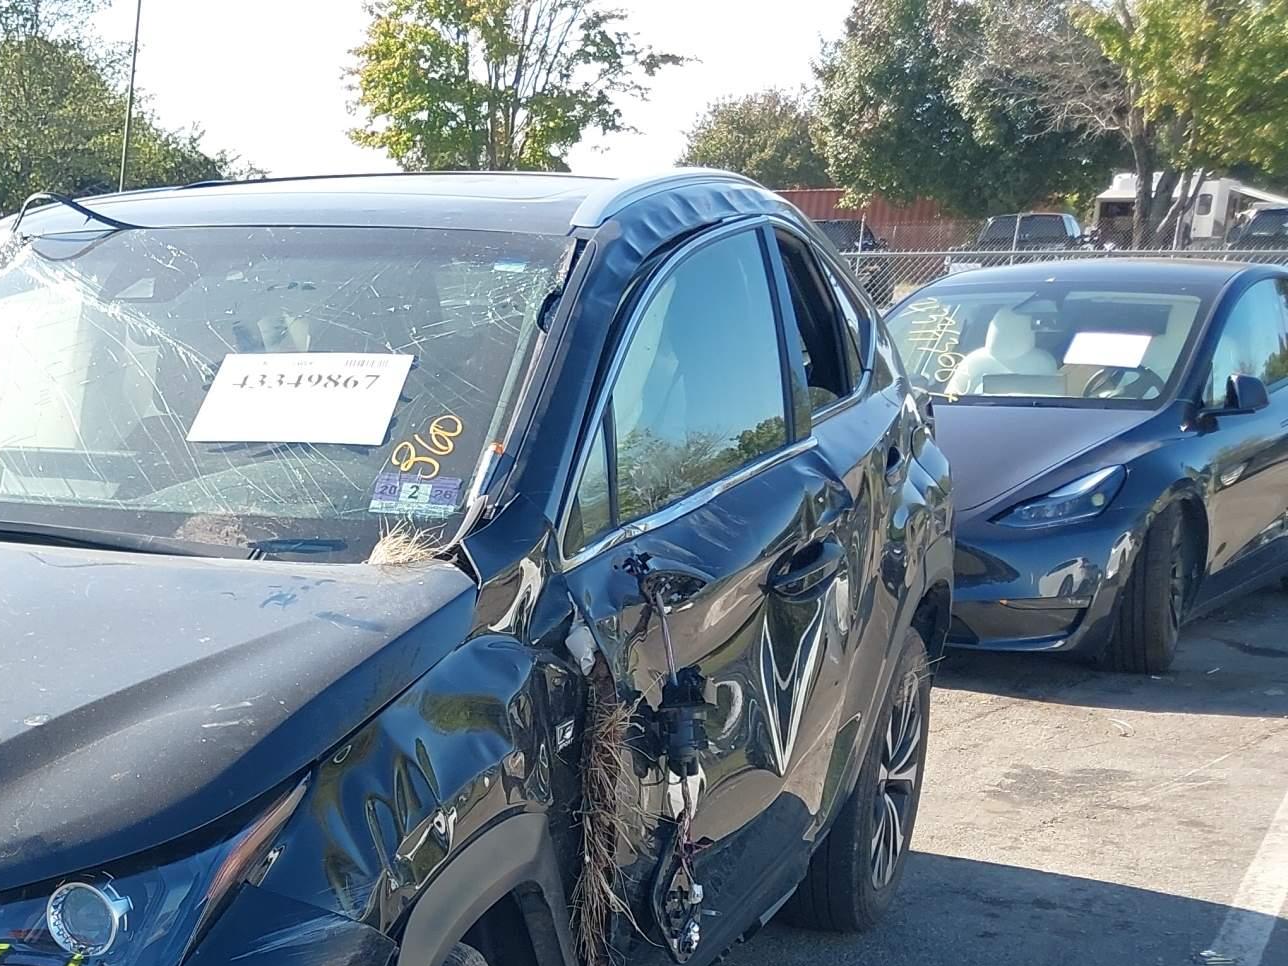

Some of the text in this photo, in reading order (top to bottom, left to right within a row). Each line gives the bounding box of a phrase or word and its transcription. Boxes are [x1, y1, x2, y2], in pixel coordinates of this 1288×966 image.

[232, 373, 381, 390] 43349867
[377, 484, 453, 500] 20 2 26
